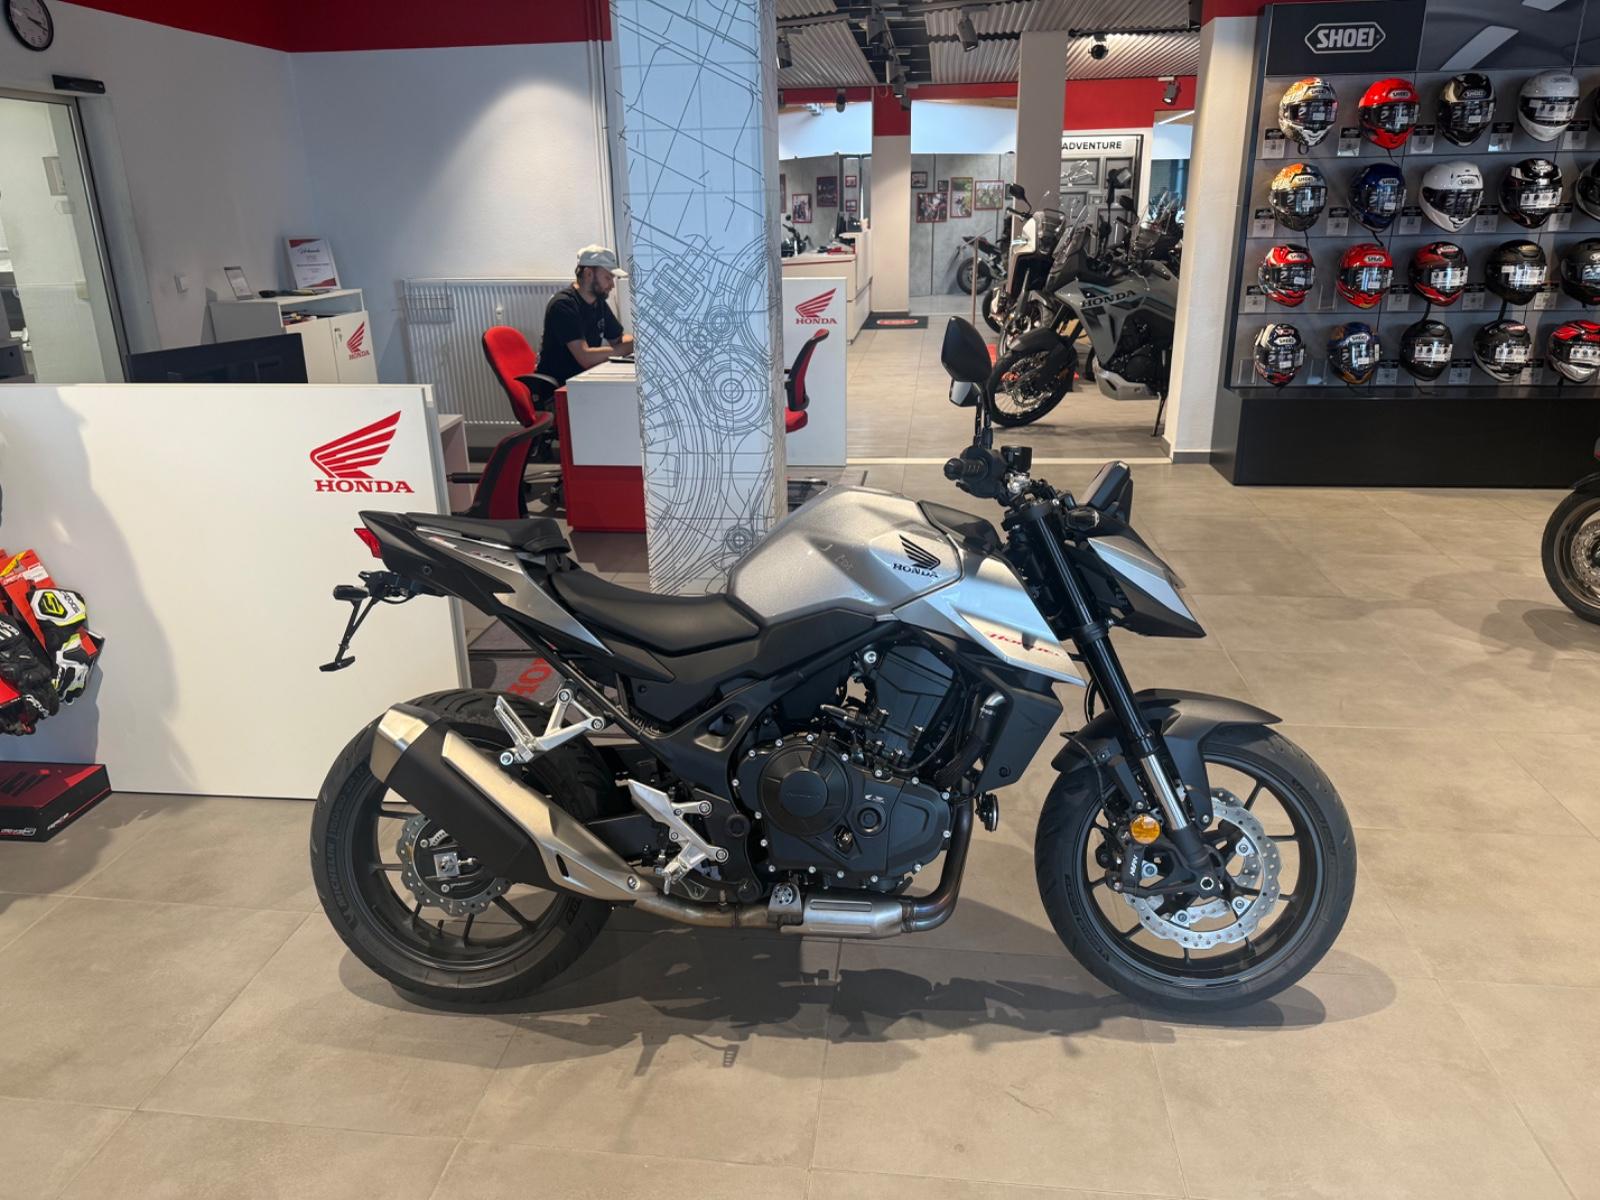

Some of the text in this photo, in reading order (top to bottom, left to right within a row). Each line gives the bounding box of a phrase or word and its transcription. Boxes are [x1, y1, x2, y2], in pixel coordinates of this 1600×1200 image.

[1316, 27, 1375, 48] SHOEI
[1061, 141, 1122, 150] ADVENTURE
[1082, 290, 1136, 307] HONDA
[314, 479, 415, 493] HONDA
[892, 562, 938, 578] HONDA
